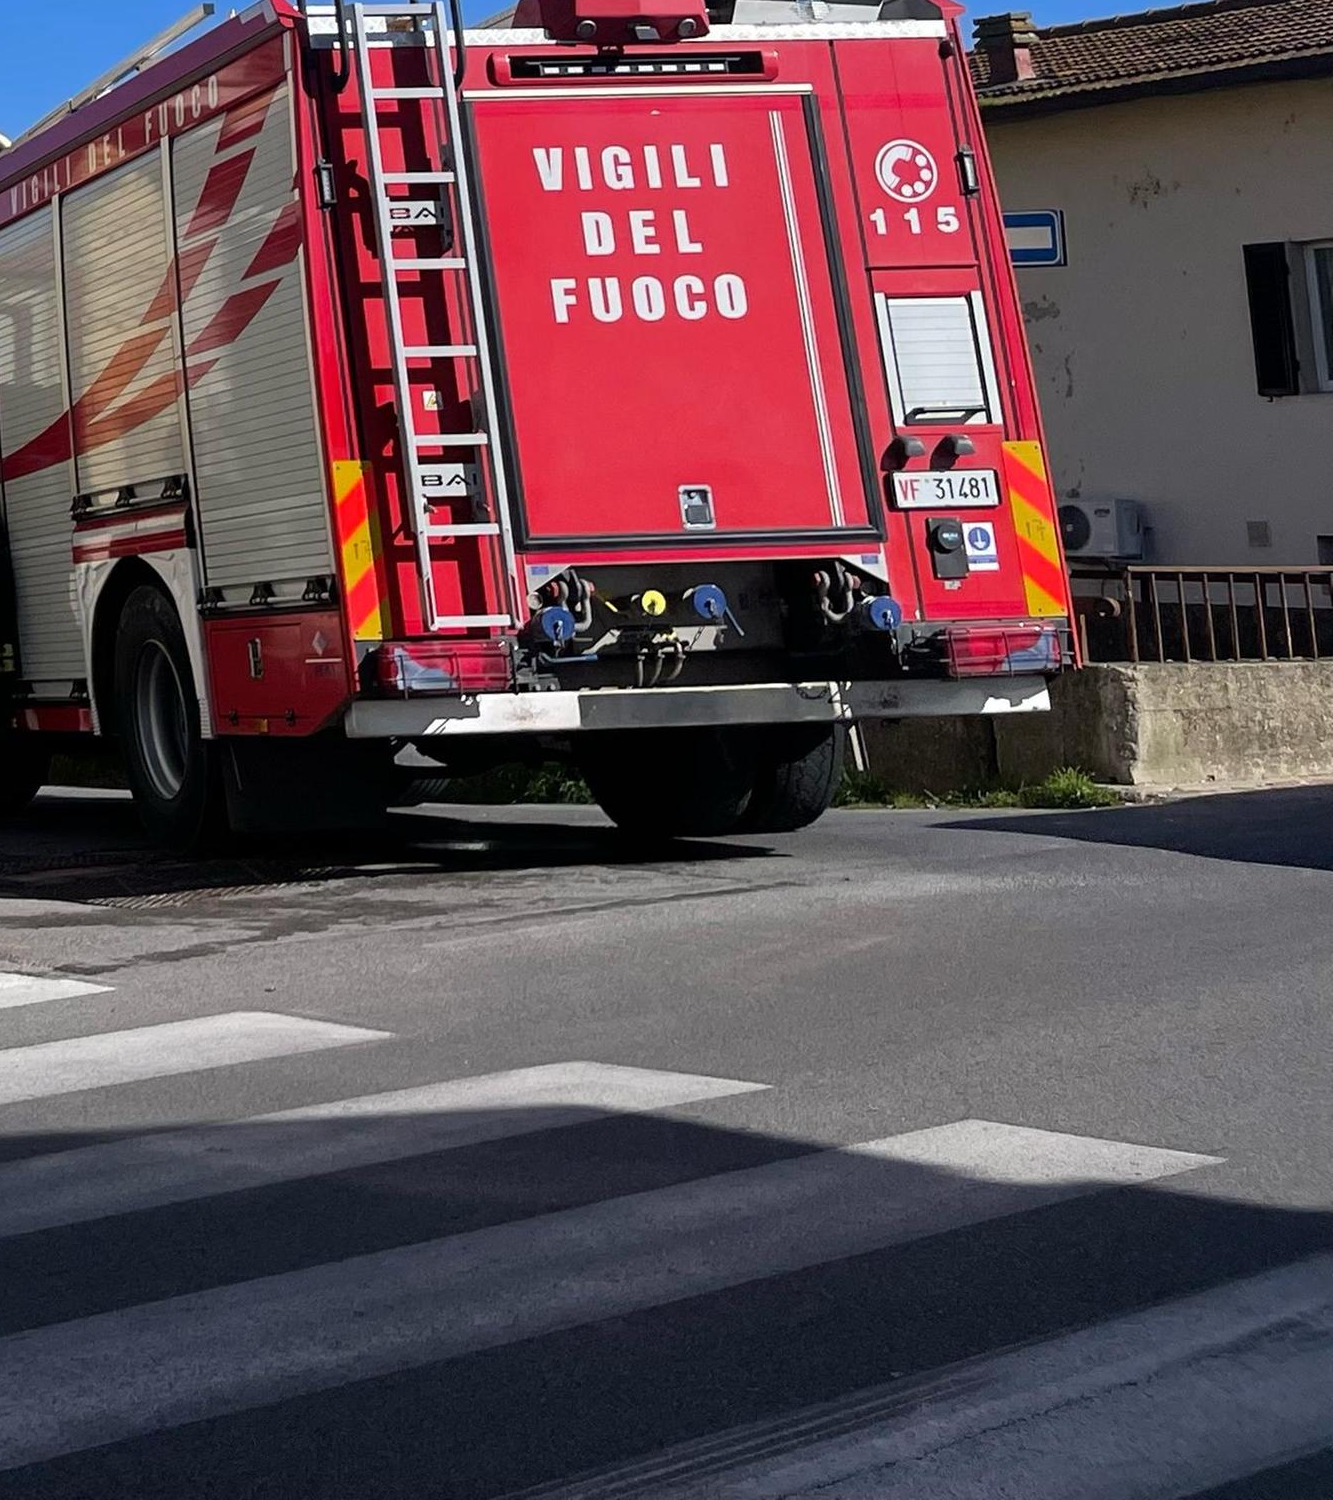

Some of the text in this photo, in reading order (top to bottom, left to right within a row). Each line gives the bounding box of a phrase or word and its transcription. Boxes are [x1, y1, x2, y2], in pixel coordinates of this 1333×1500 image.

[10, 74, 218, 215] VIGILI DEL FUOCO
[532, 143, 729, 191] VIGILI
[581, 209, 704, 256] DEL
[869, 206, 960, 235] 115
[550, 273, 749, 324] FUOCO
[420, 474, 477, 487] BAI
[898, 477, 989, 501] VF 31481
